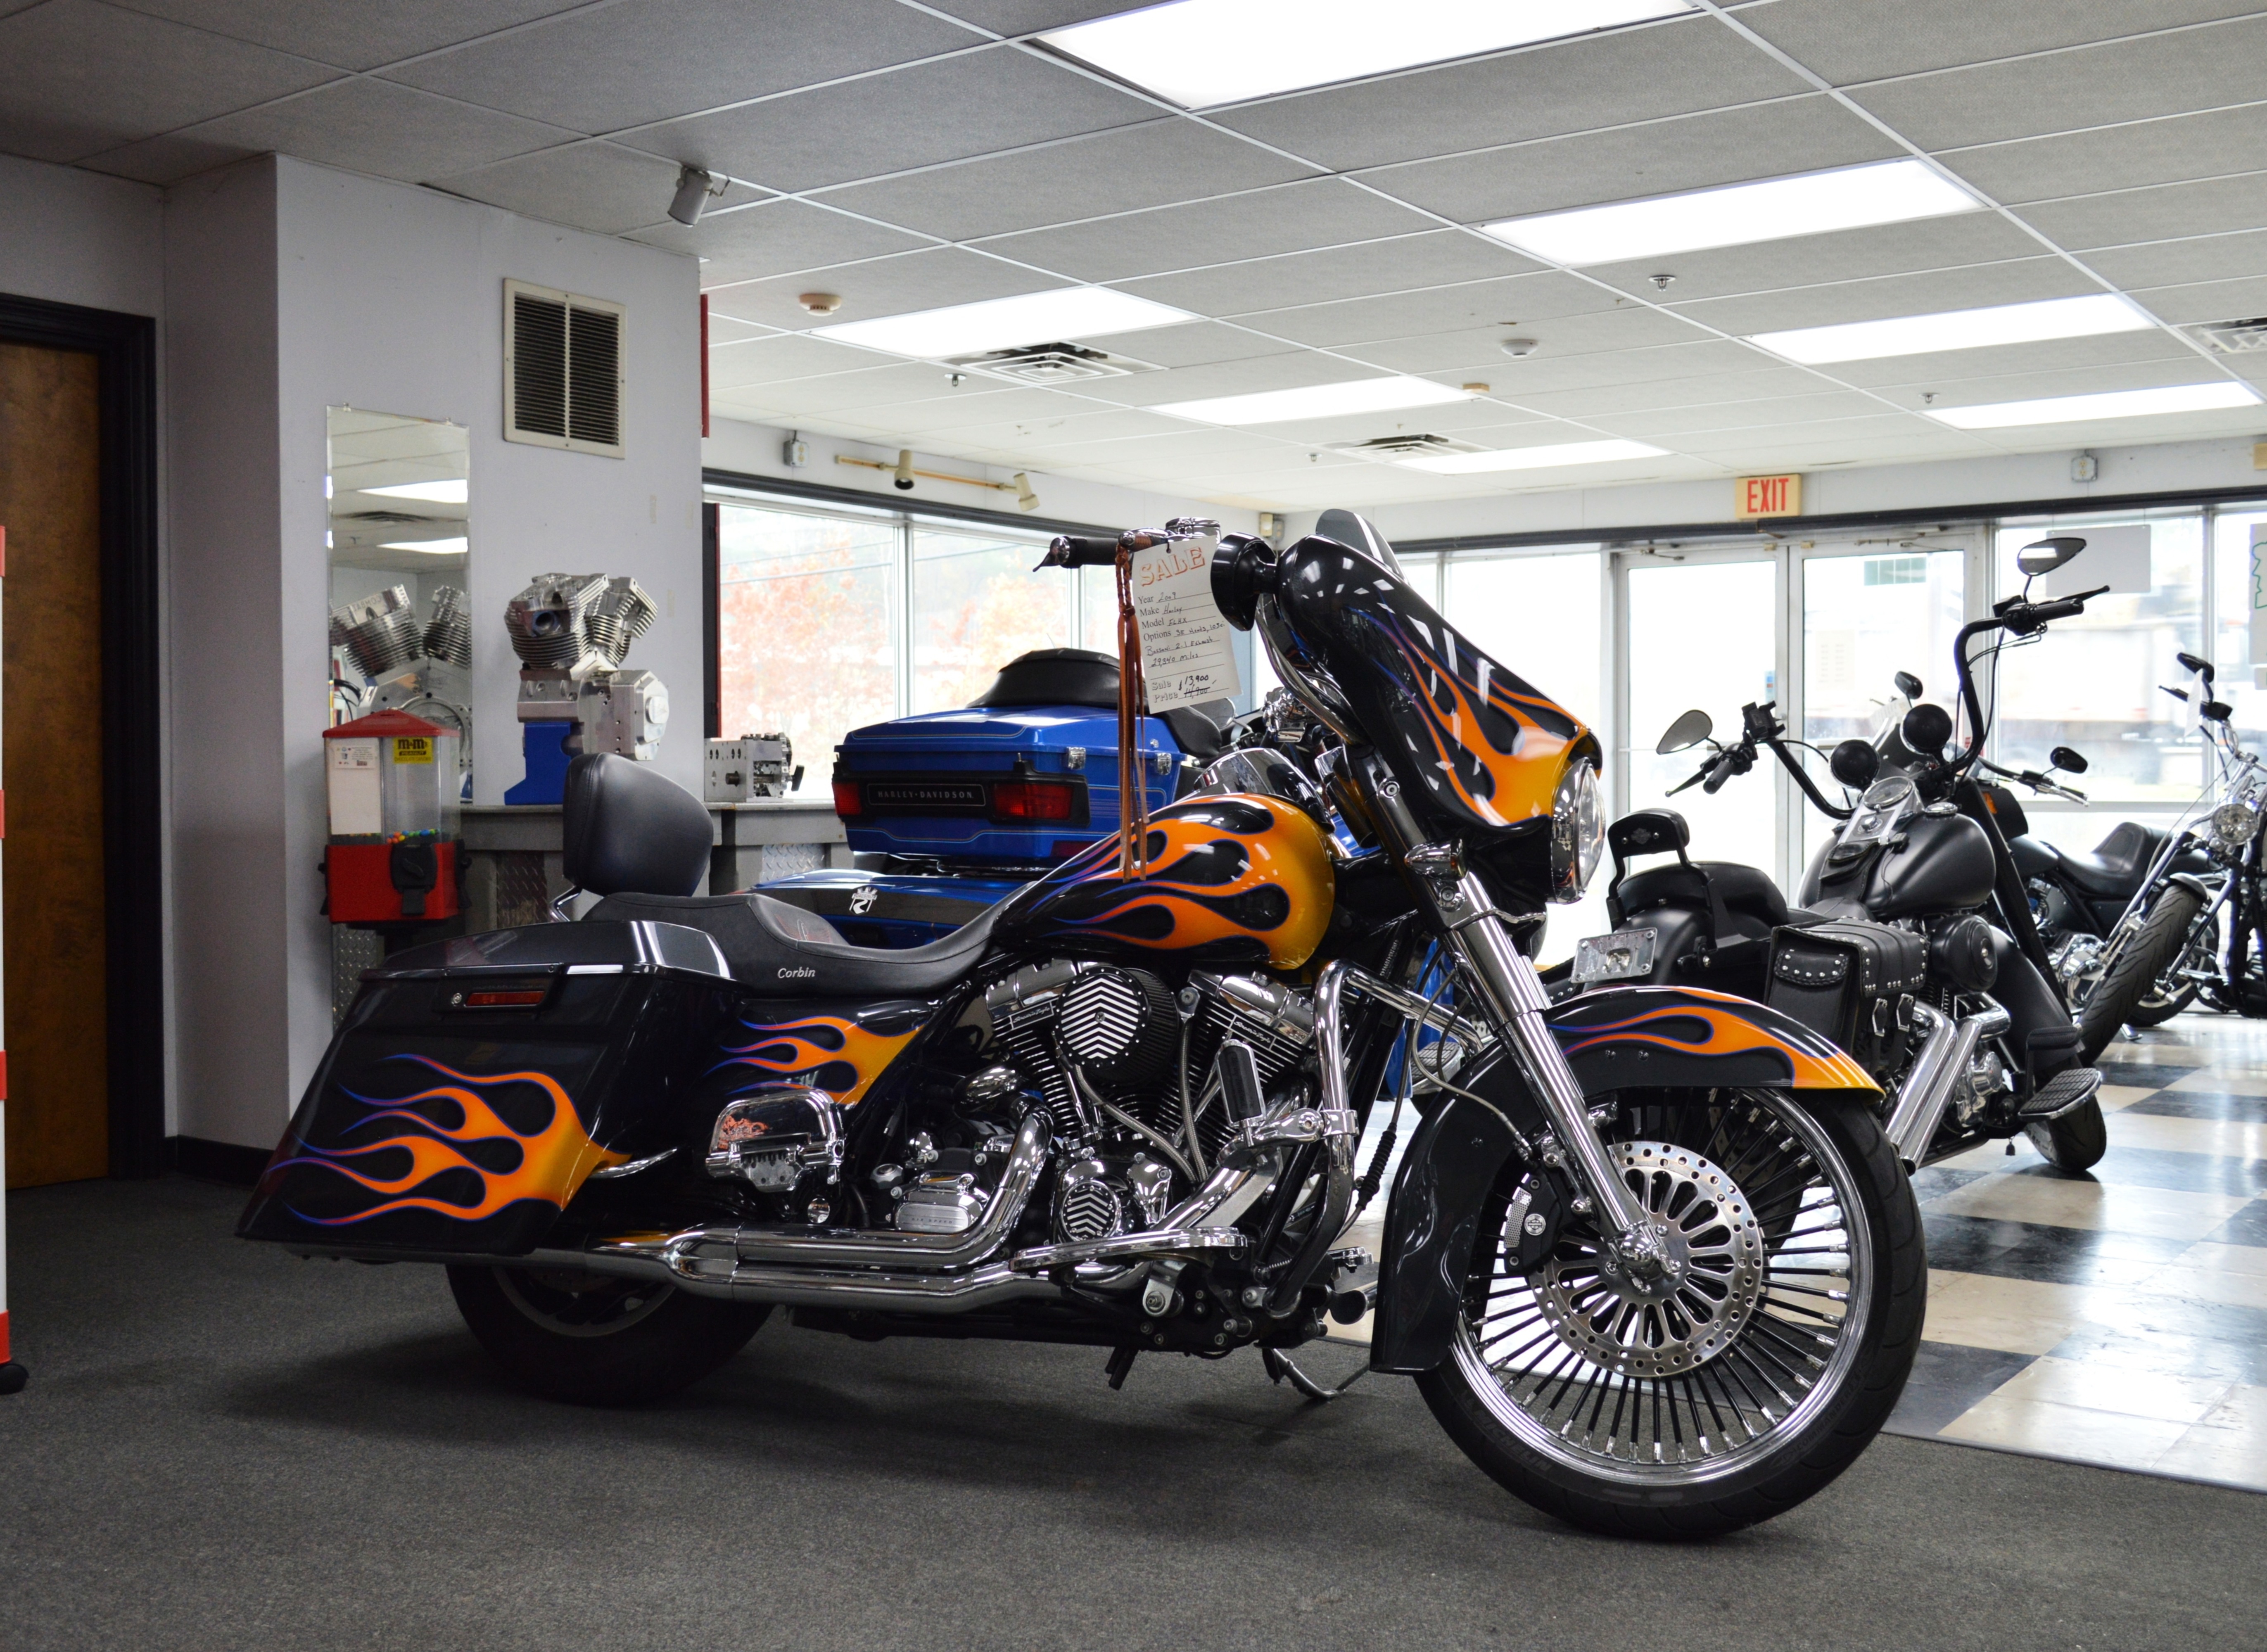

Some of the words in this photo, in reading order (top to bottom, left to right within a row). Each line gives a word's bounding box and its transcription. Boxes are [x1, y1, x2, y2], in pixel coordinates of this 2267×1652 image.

[1747, 477, 1789, 513] EXIT
[1139, 546, 1205, 586] SALE
[1158, 592, 1176, 602] 2009
[1140, 608, 1159, 617] Make
[1163, 603, 1182, 614] Harley
[1142, 617, 1164, 629] Model
[1143, 630, 1171, 642] Options
[1151, 656, 1175, 667] 29,340
[1152, 680, 1172, 691] Sale
[1154, 692, 1178, 703] Price
[777, 966, 816, 978] Corbin
[1475, 1410, 1553, 1471] MICHELIN
